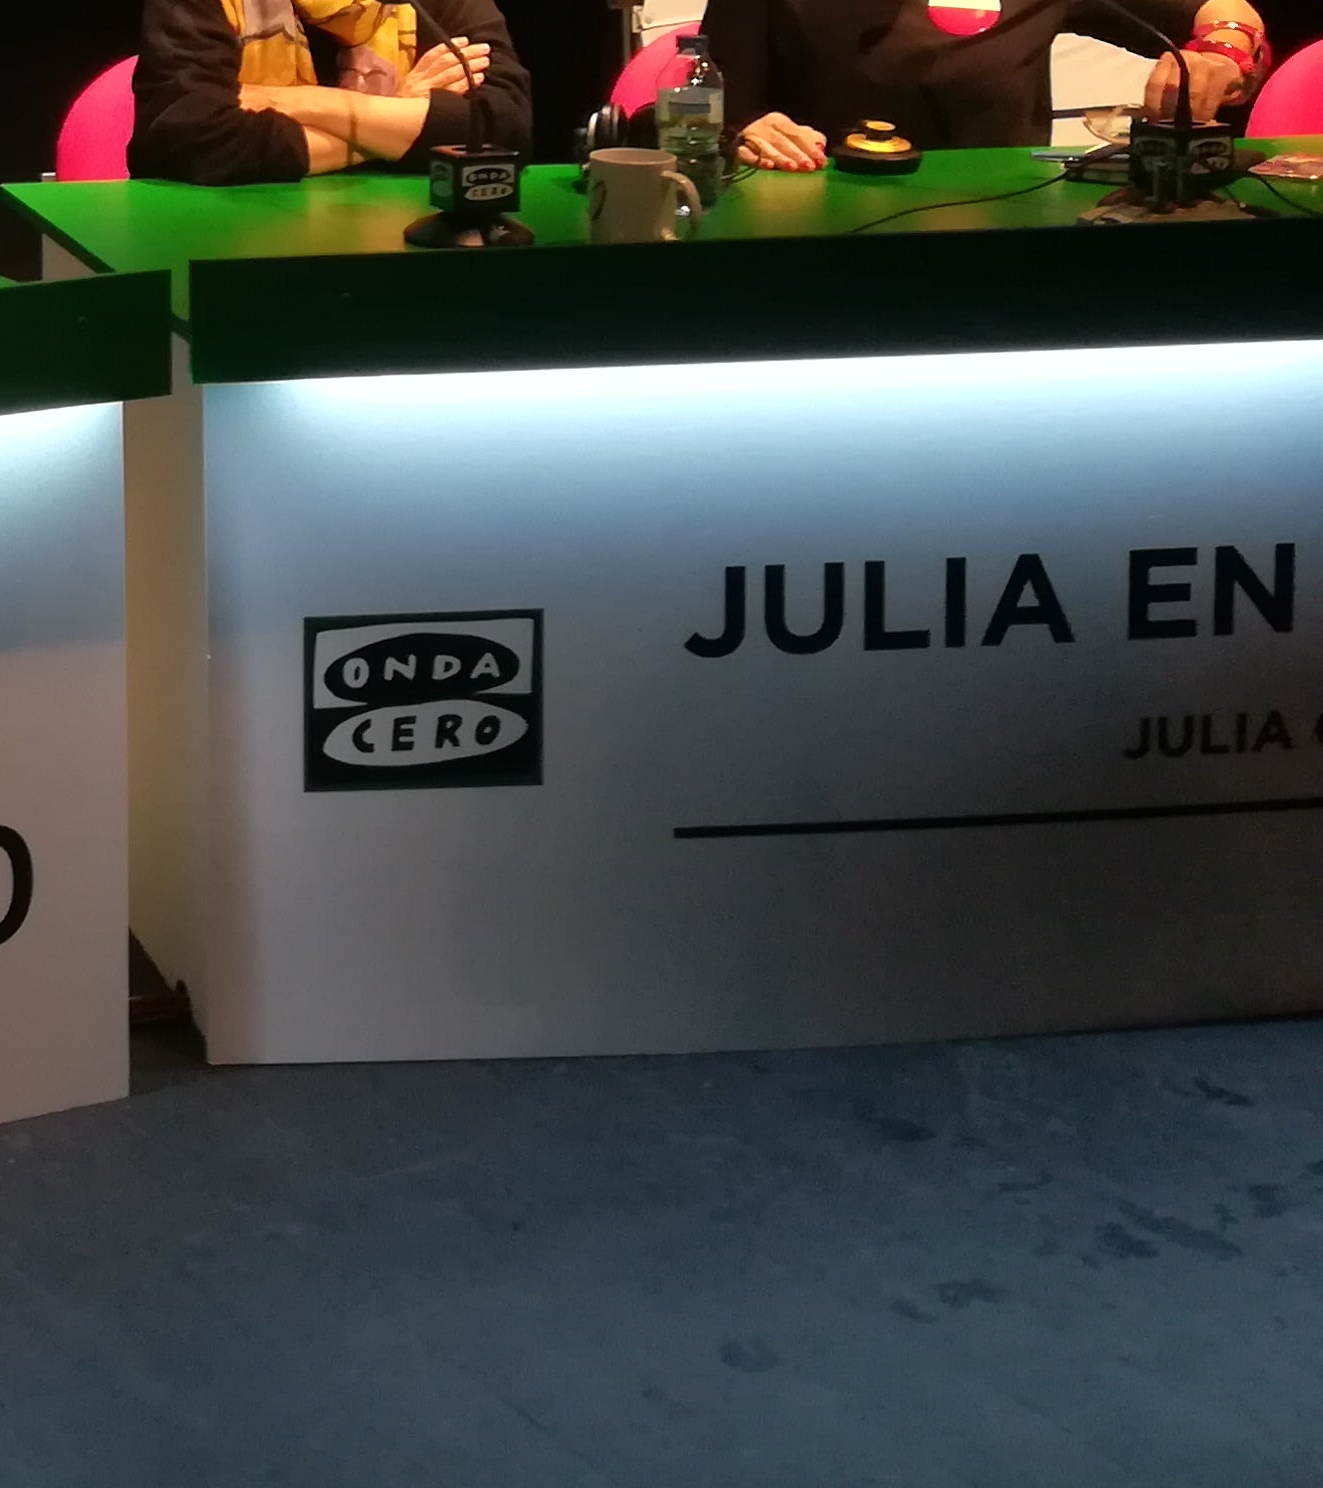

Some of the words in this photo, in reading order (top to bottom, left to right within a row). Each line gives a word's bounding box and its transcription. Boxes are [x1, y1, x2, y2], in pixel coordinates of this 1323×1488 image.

[684, 553, 1076, 658] JULIA
[1128, 542, 1296, 640] EN
[342, 652, 501, 689] ONDA
[351, 714, 502, 754] CERO
[1122, 710, 1295, 760] JULIA
